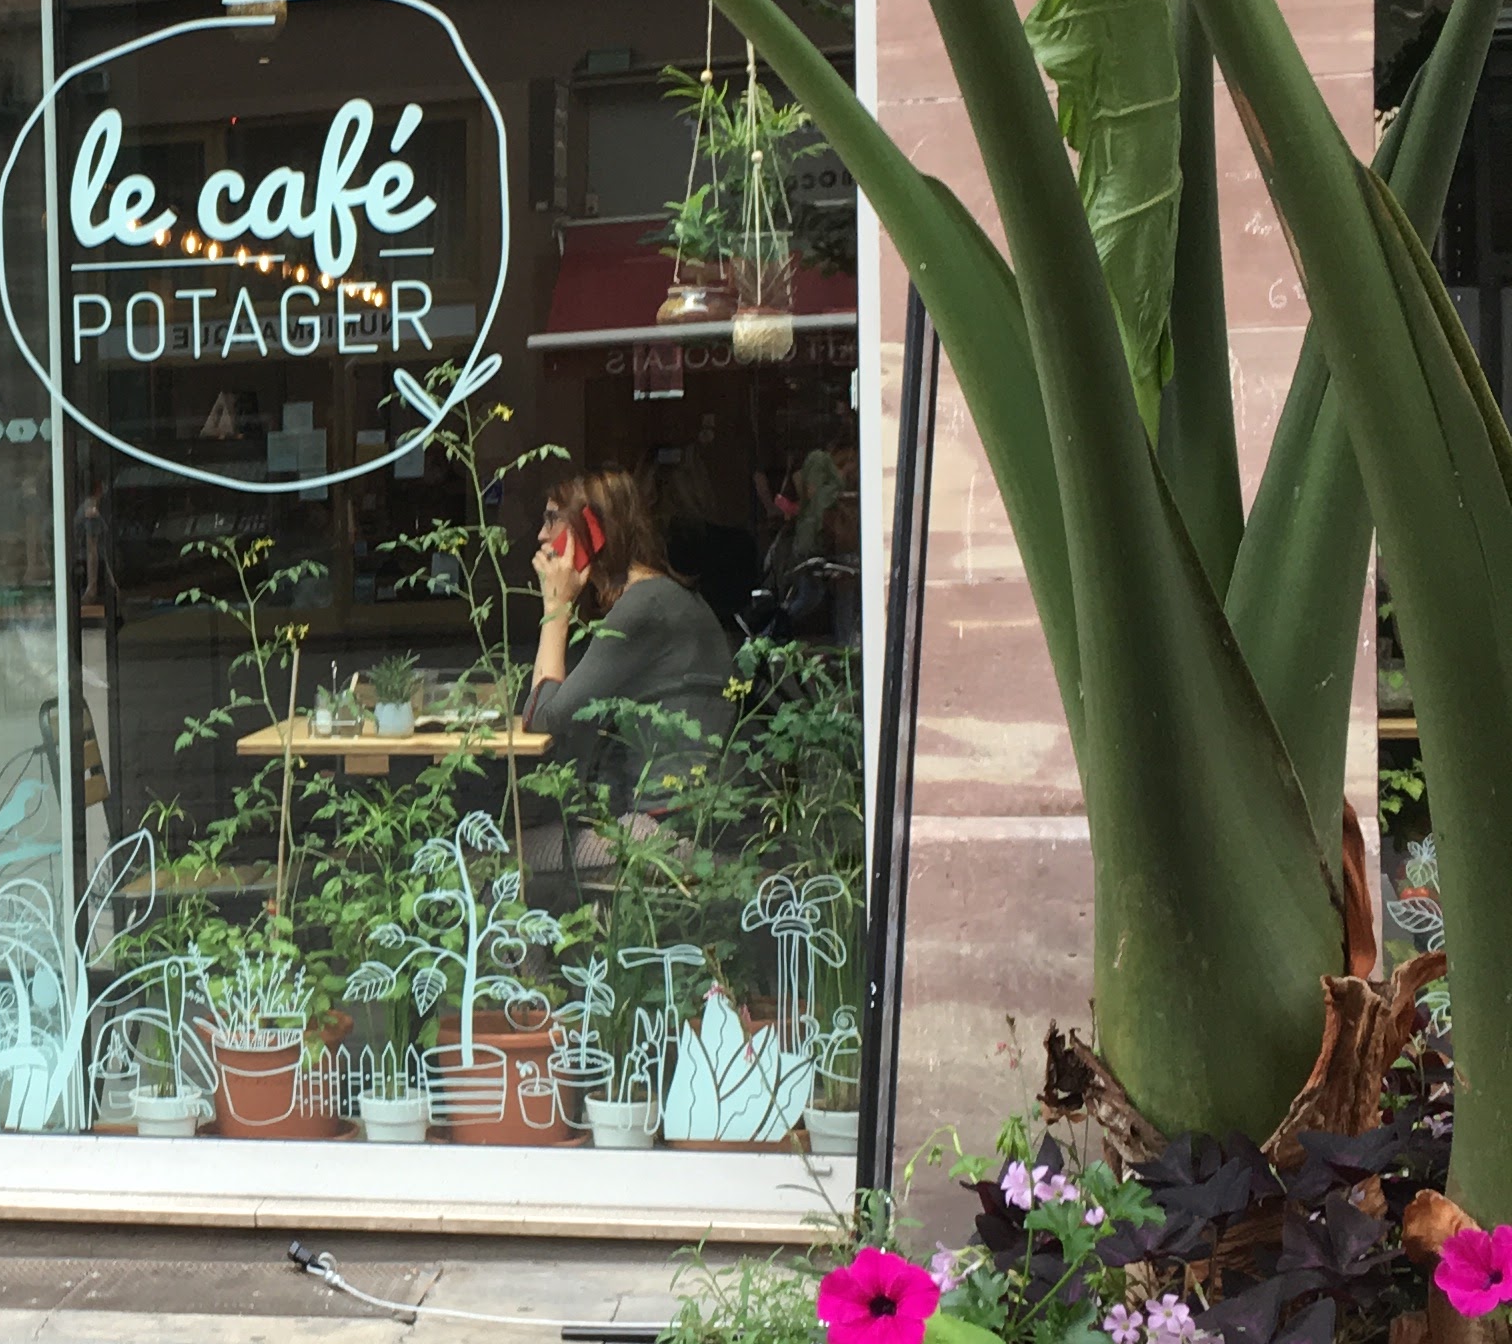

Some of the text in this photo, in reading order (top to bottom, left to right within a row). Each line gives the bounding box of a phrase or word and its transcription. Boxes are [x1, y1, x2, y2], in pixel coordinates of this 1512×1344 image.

[70, 98, 436, 278] le café
[73, 280, 433, 364] POTAGER
